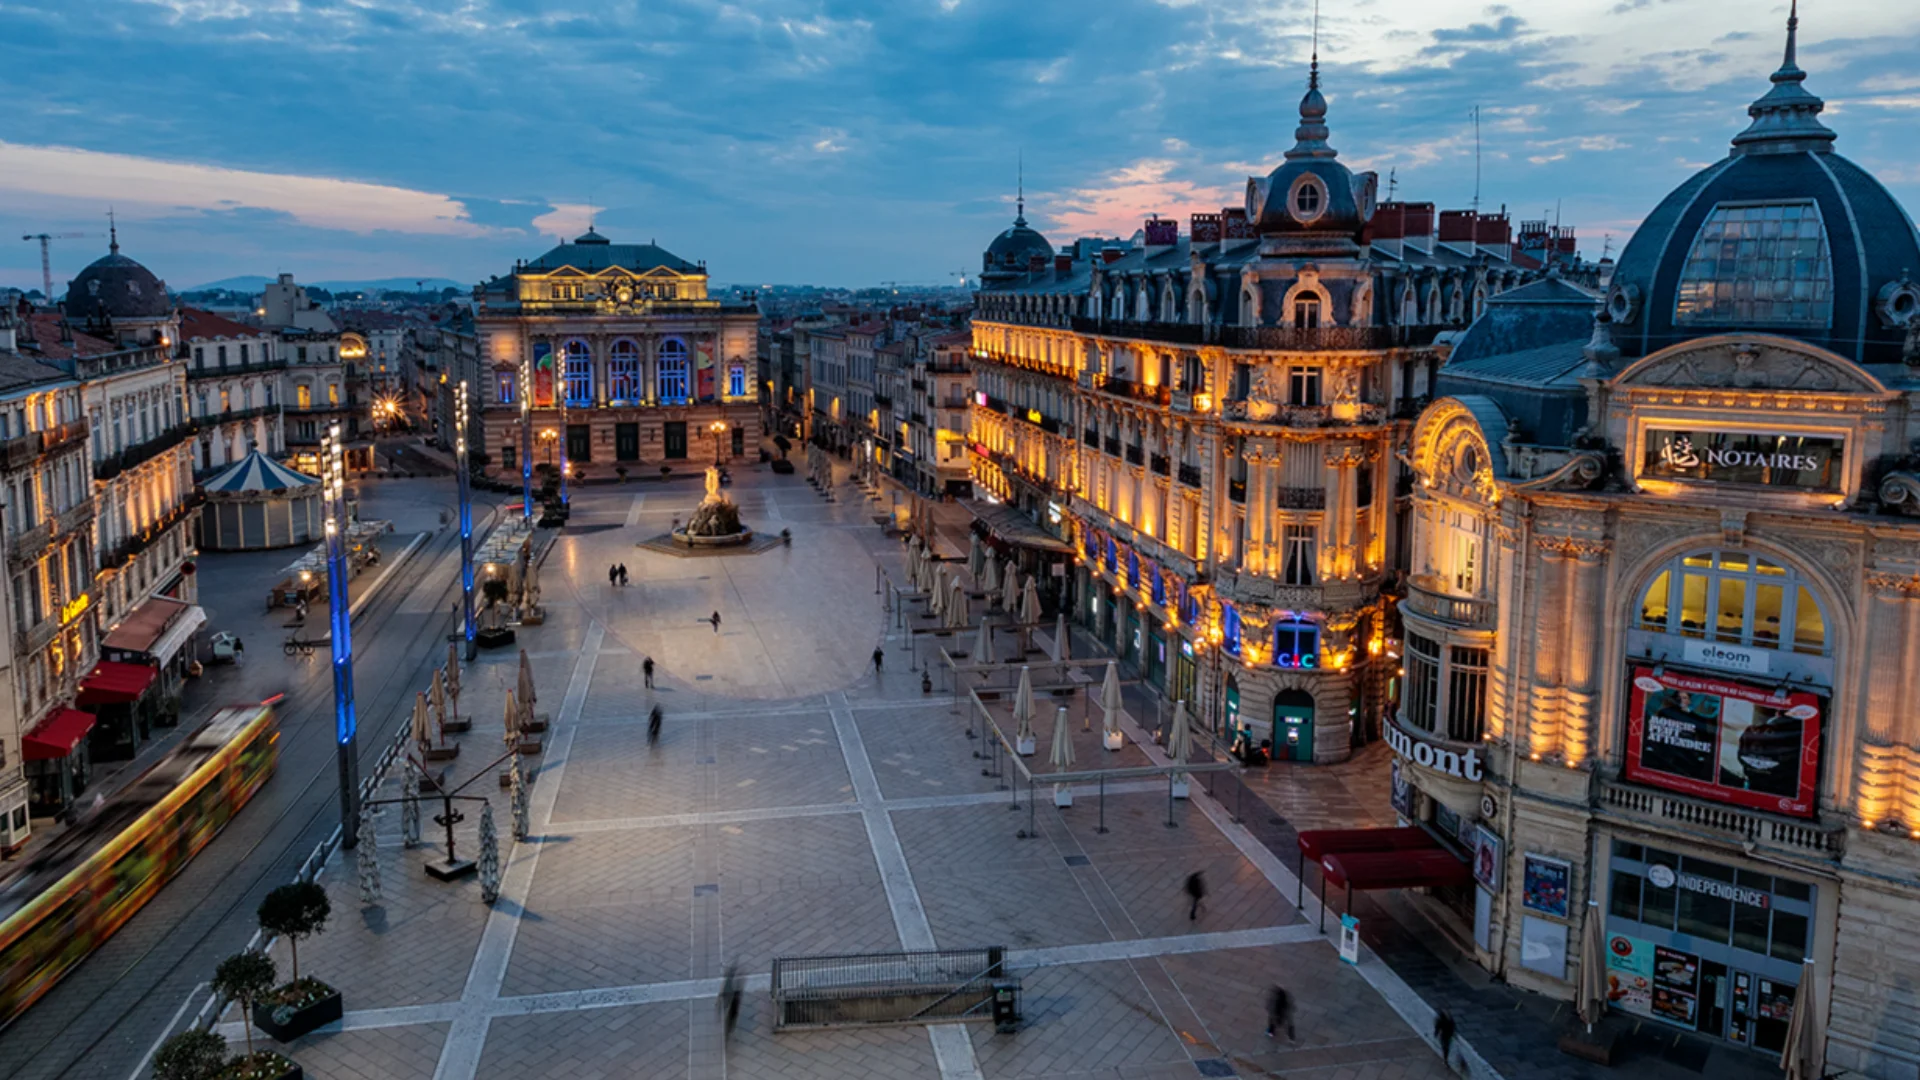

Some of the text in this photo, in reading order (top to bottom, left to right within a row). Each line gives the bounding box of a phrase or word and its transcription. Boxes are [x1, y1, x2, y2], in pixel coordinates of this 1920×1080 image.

[1705, 447, 1818, 471] NOTAIRES
[1278, 653, 1315, 669] CIC
[1679, 874, 1763, 908] INDEPENDENCE
